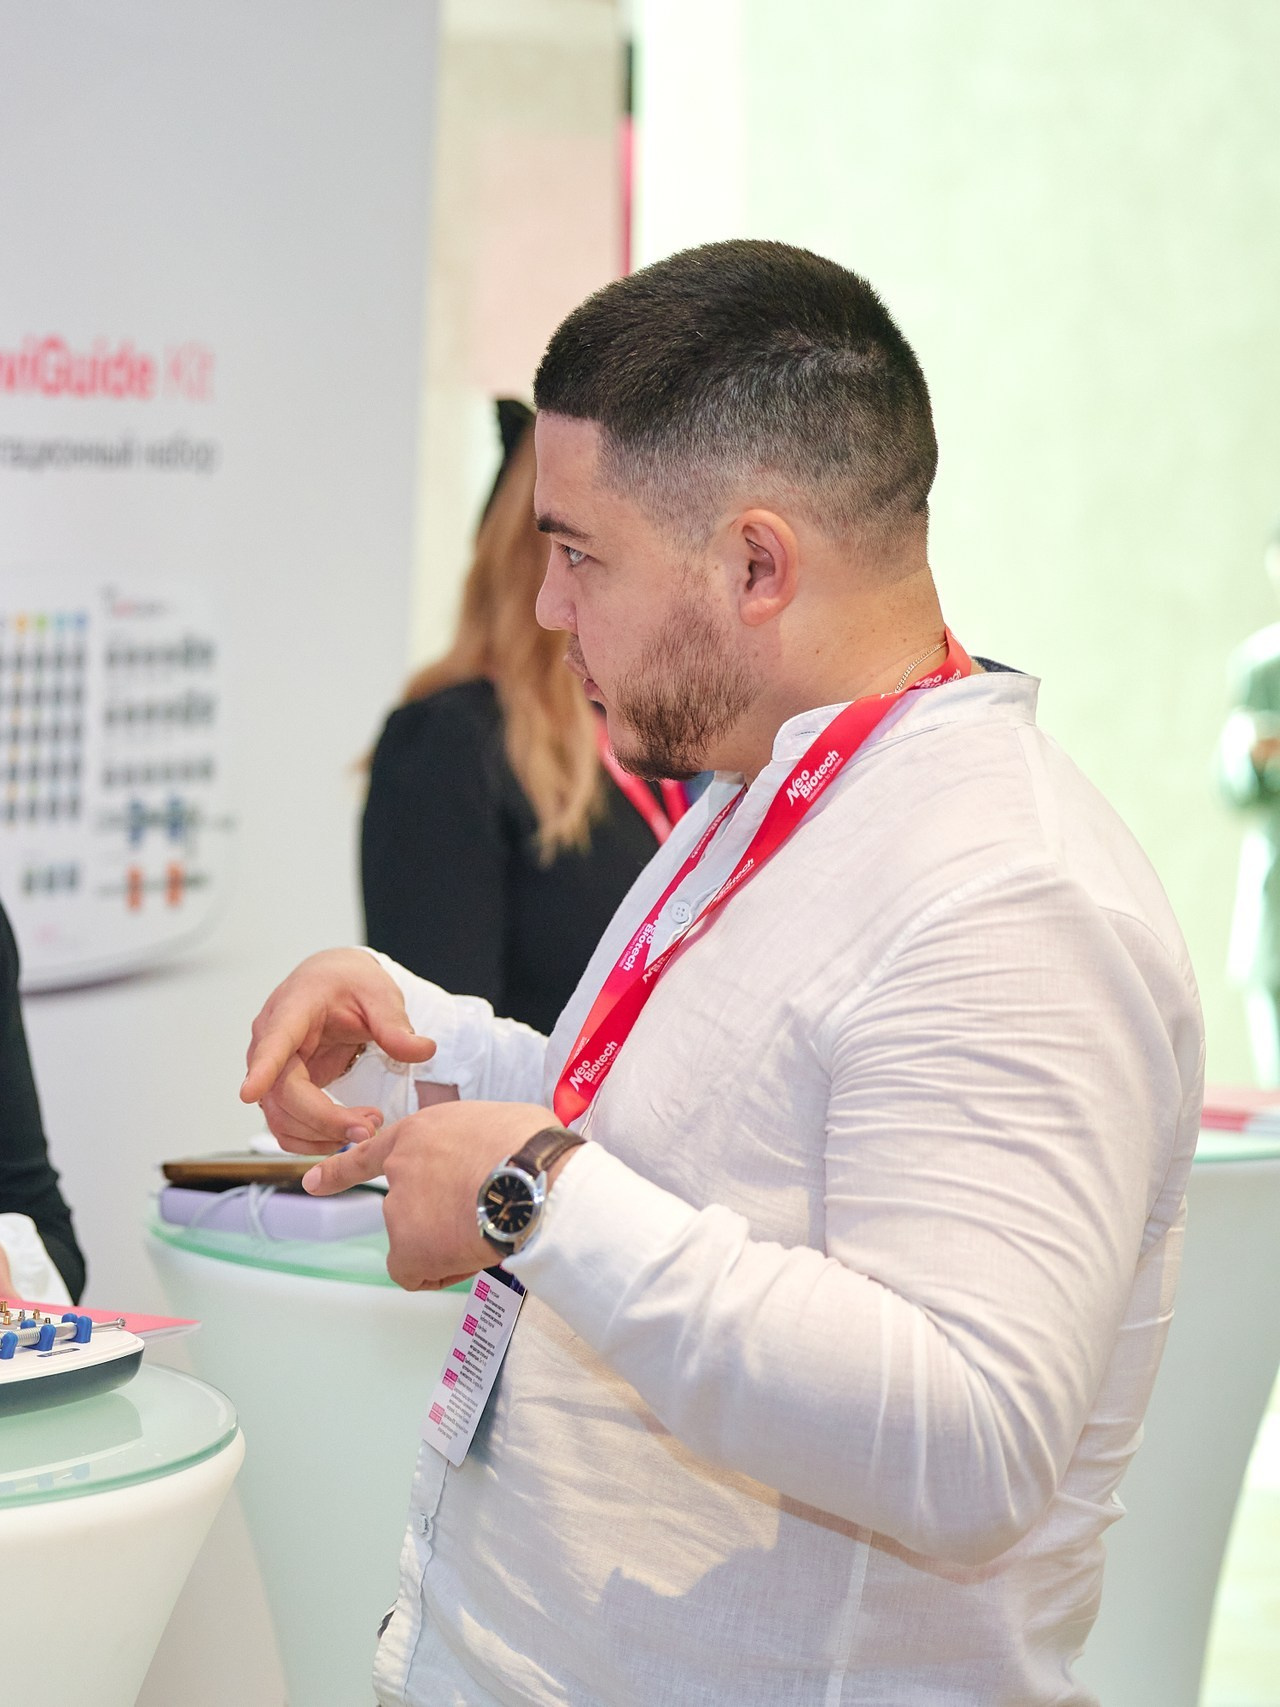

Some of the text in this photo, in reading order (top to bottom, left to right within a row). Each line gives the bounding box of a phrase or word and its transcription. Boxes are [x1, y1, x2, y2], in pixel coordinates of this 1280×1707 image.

[786, 770, 810, 807] Neo
[799, 750, 840, 799] Biotech
[623, 923, 654, 972] Biotech
[569, 1060, 591, 1092] Neo
[583, 1041, 618, 1083] Biotech
